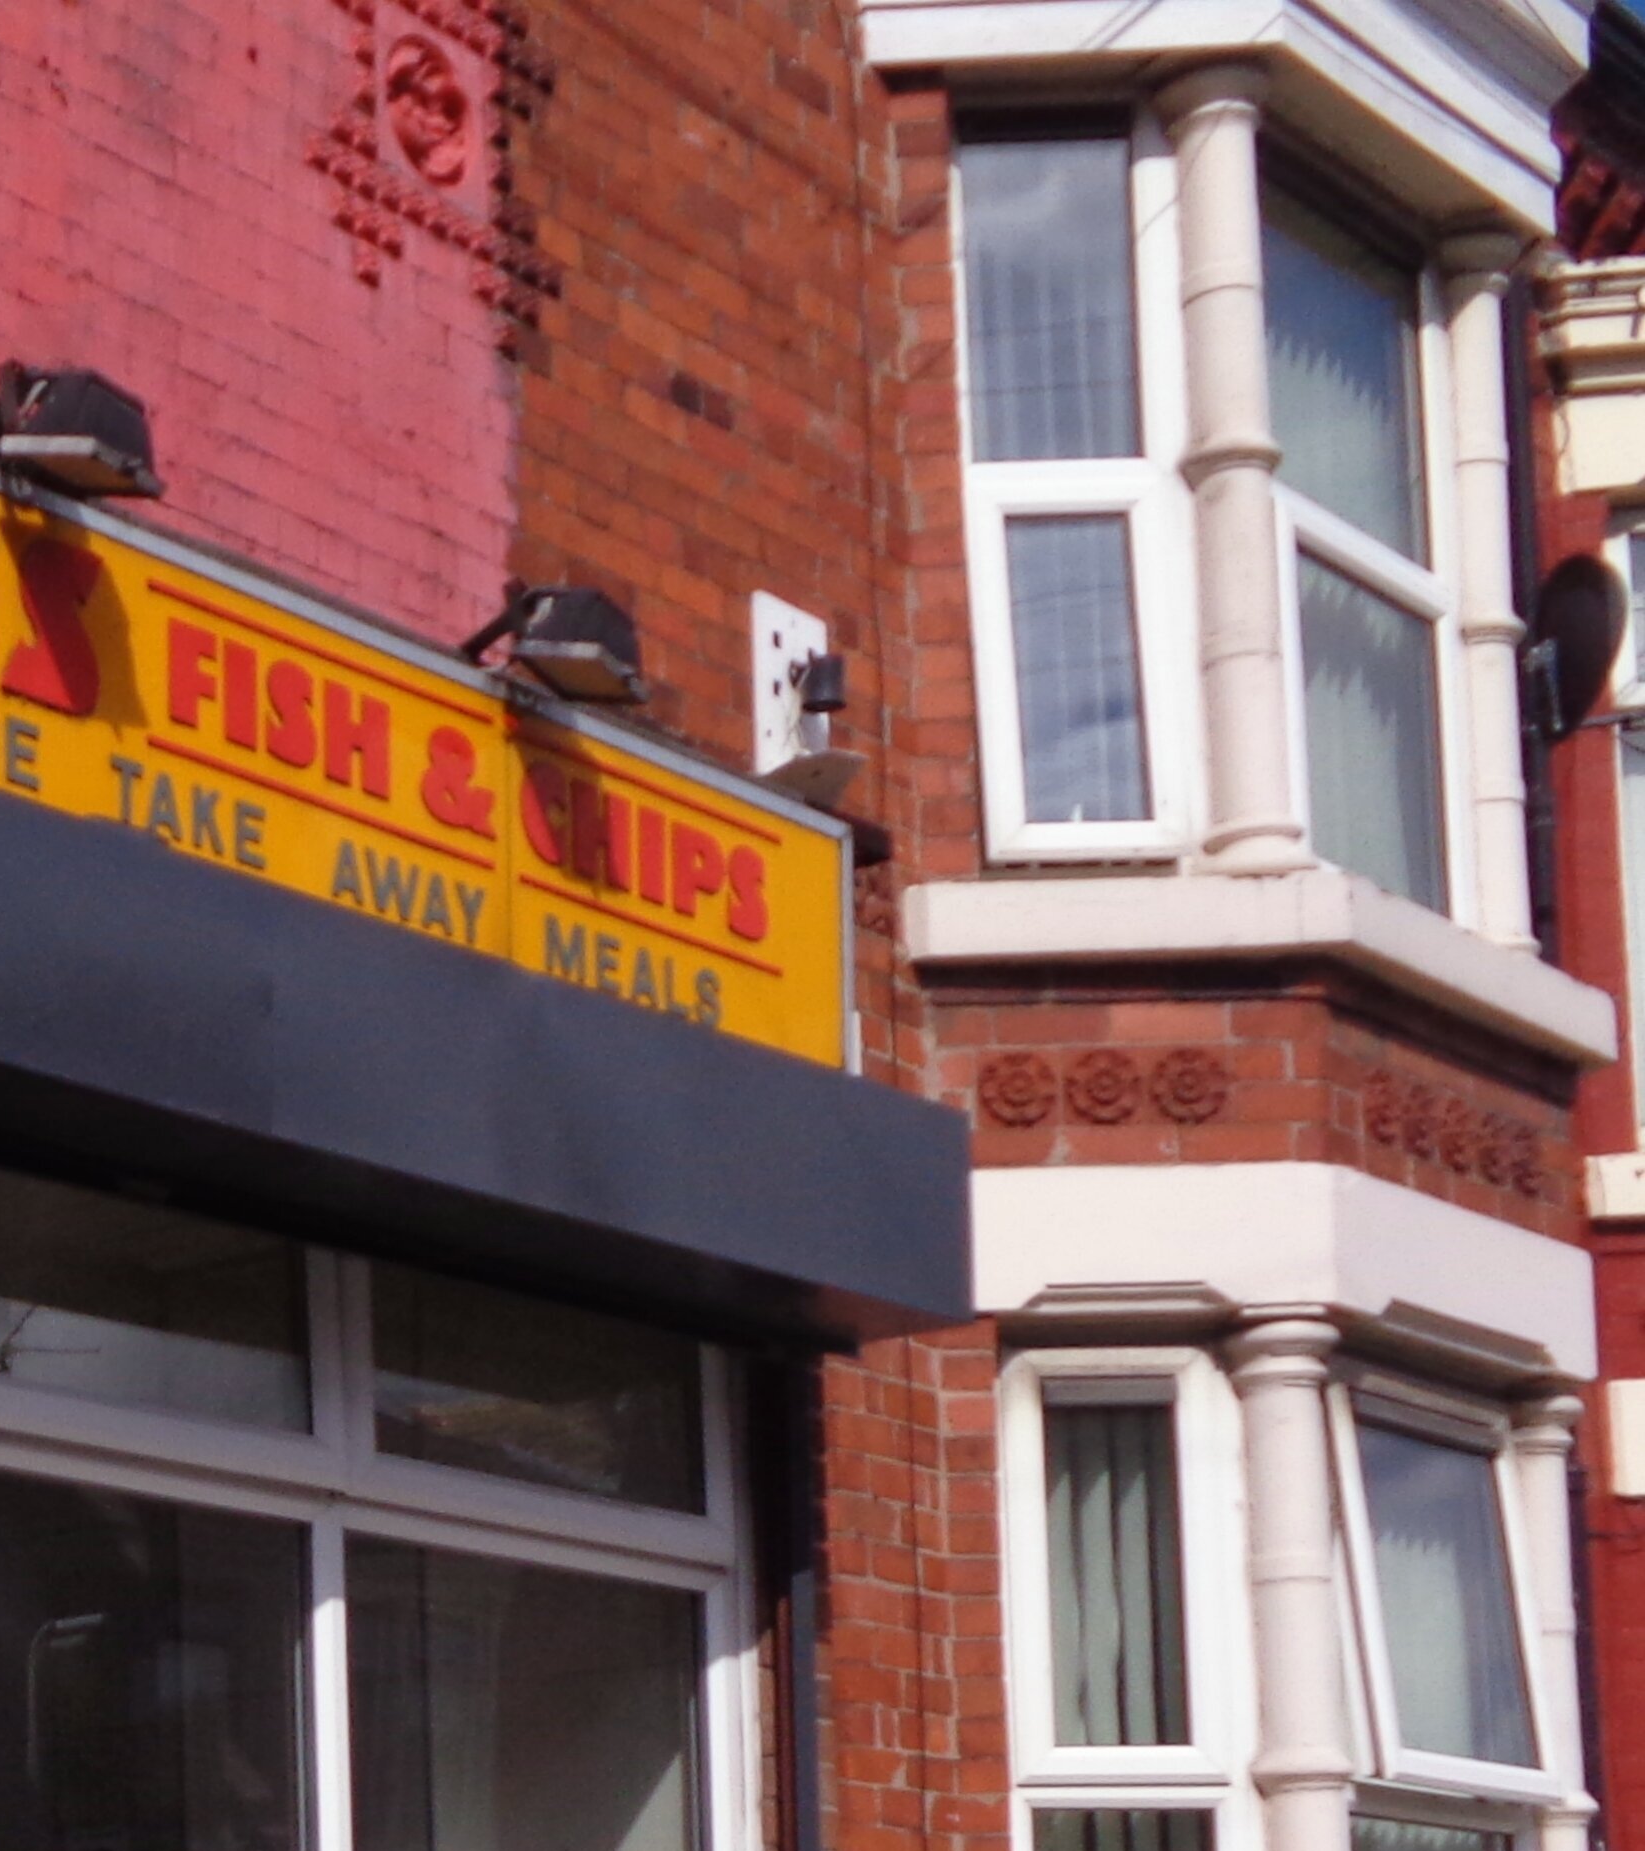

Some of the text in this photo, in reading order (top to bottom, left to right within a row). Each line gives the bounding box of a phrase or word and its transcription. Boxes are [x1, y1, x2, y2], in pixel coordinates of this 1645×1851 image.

[111, 754, 267, 871] TAKE
[331, 839, 486, 945] AWAY
[544, 911, 721, 1028] MEALS
[166, 616, 769, 942] FISH & CHIPS
